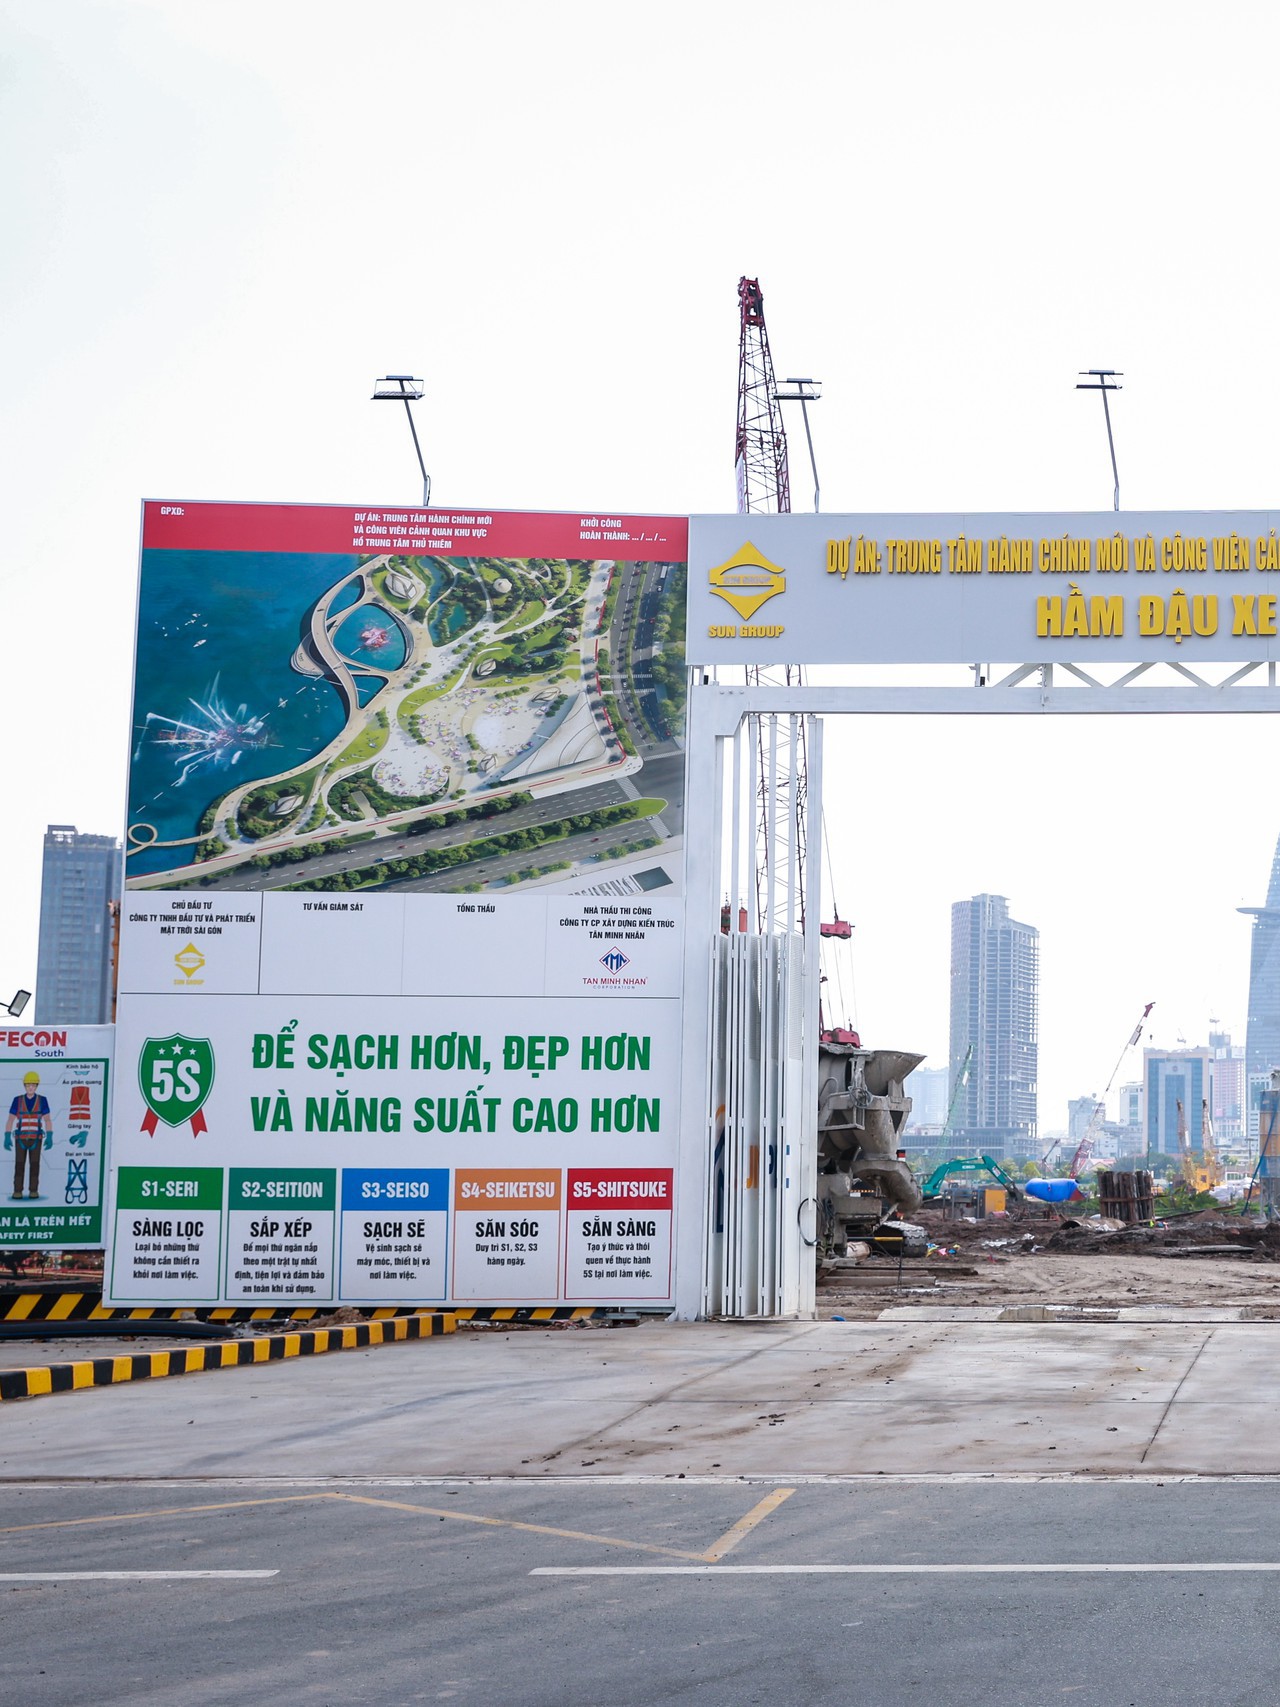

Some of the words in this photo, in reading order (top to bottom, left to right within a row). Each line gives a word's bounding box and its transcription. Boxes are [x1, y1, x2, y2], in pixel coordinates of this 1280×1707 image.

[580, 517, 598, 527] KHỞI
[411, 537, 426, 548] THỦ
[826, 536, 852, 581] DỰ
[853, 534, 882, 576] ÁN:
[885, 539, 943, 576] TRUNG
[946, 534, 983, 576] TÂM
[986, 535, 1034, 576] HÀNH
[1037, 533, 1092, 575] CHÍNH
[1095, 532, 1130, 575] MỚI
[1133, 533, 1157, 574] VÀ
[1160, 531, 1208, 575] CÔNG
[1211, 531, 1251, 574] VIÊN
[1036, 582, 1124, 640] HẦM
[1137, 587, 1218, 643] ĐẬU
[1231, 594, 1278, 639] XE
[708, 625, 737, 639] SUN
[738, 625, 785, 639] GROUP
[251, 1019, 298, 1069] ĐỂ
[307, 1034, 399, 1077] SẠCH
[411, 1031, 491, 1075] HƠN,
[502, 1035, 569, 1078] ĐẸP
[581, 1032, 650, 1071] HƠN
[150, 1058, 201, 1103] 5S
[250, 1089, 293, 1132] VÀ
[305, 1089, 401, 1133] NĂNG
[413, 1085, 501, 1133] SUẤT
[512, 1097, 578, 1133] CAO
[591, 1094, 660, 1133] HƠN
[141, 1180, 198, 1197] S1-SERI
[242, 1181, 323, 1198] S2-SEITION
[361, 1182, 429, 1198] S3-SEISO
[461, 1182, 555, 1198] S4-SEIKETSU
[573, 1181, 667, 1198] S5-SHITSUKE
[132, 1217, 172, 1237] SÀNG
[176, 1221, 204, 1240] LỌC
[250, 1215, 279, 1237] SẮP
[284, 1217, 312, 1237] XẾP
[363, 1222, 402, 1241] SẠCH
[407, 1219, 425, 1238] SẼ
[475, 1218, 505, 1238] SĂN
[510, 1218, 539, 1237] SÓC
[582, 1215, 612, 1237] SẴN
[616, 1217, 656, 1236] SÀNG
